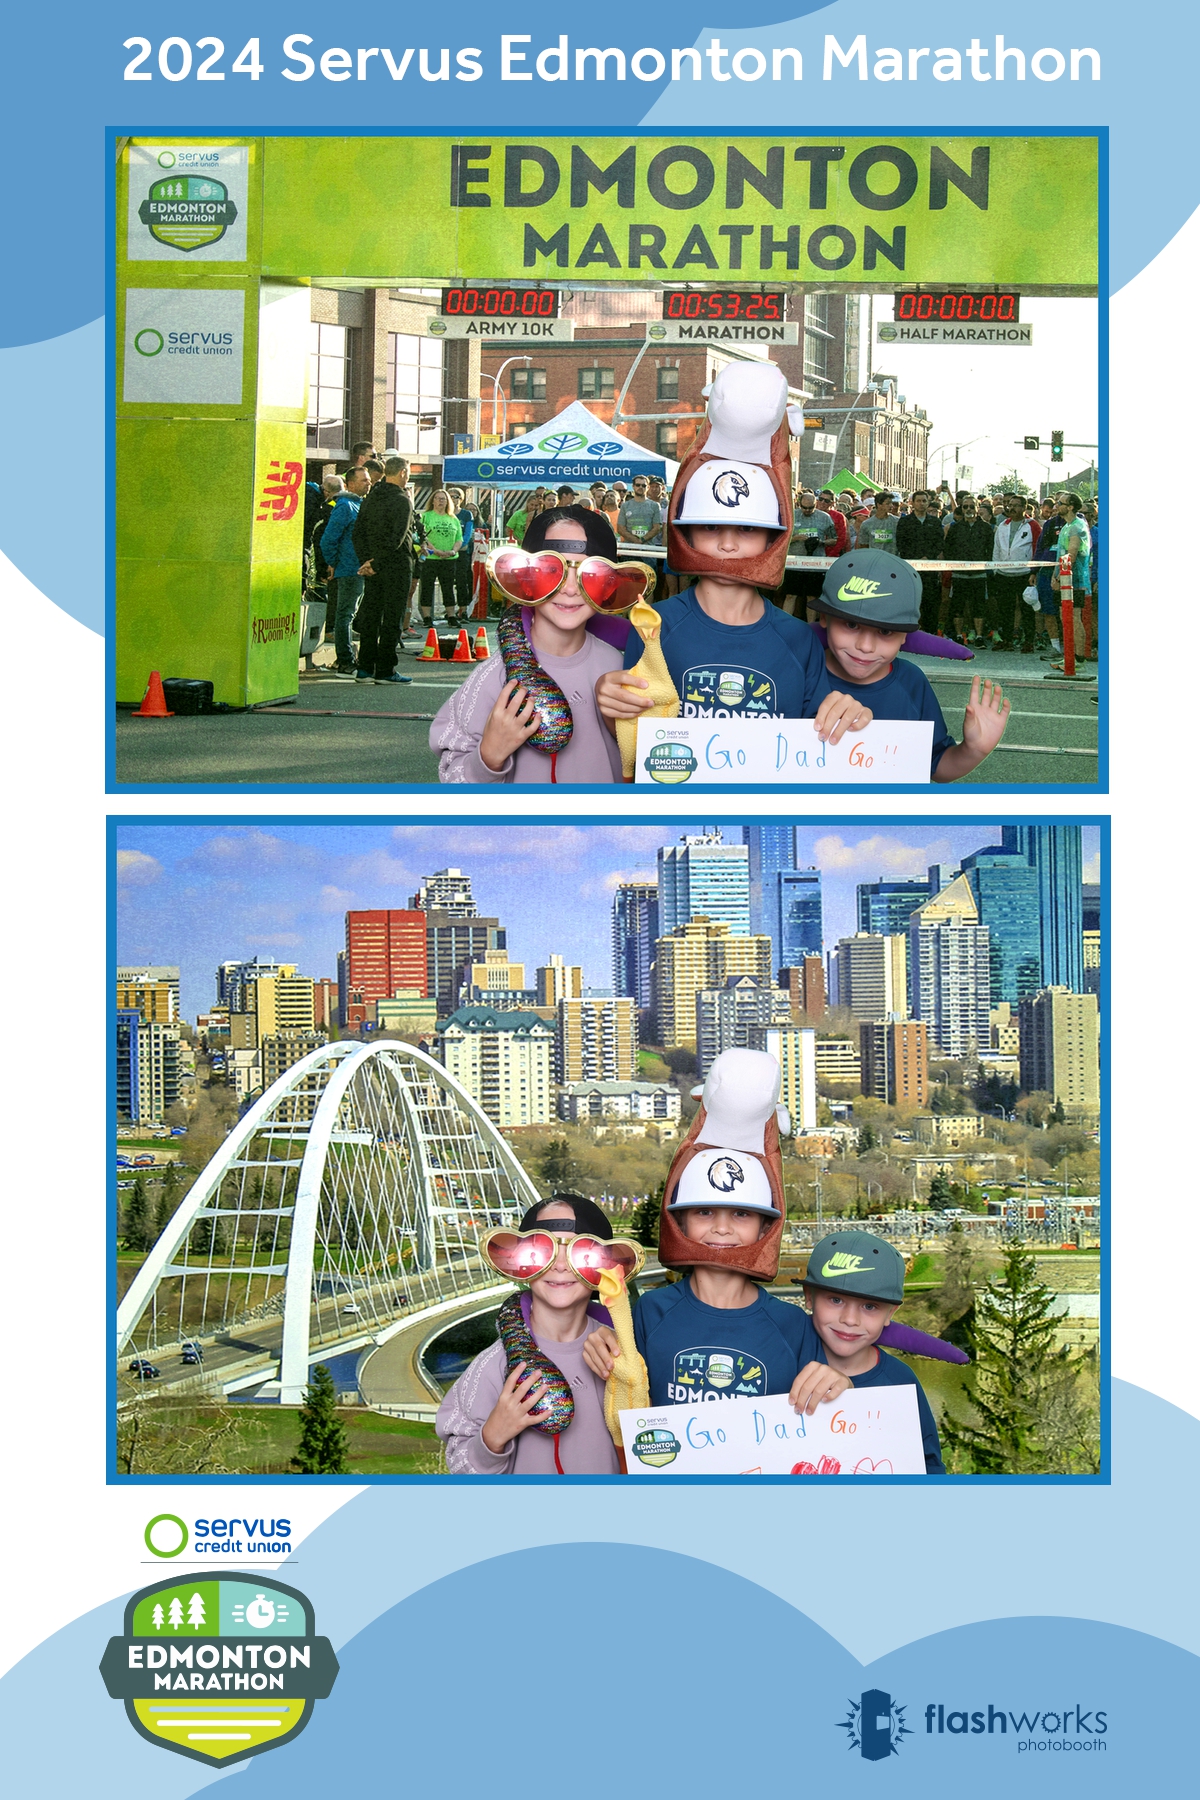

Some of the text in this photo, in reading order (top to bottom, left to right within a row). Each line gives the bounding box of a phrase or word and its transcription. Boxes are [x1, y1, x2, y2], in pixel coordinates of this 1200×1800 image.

[178, 152, 219, 161] servus
[449, 145, 991, 211] EDMONTON
[149, 203, 227, 214] EDMONTON
[160, 214, 215, 222] MARATHON
[523, 223, 907, 271] MARATHON
[465, 321, 554, 336] ARMY 10K
[678, 325, 785, 340] MARATHON
[900, 328, 939, 340] HALF
[943, 328, 1031, 341] MARATHON
[168, 331, 233, 345] servus
[167, 345, 233, 355] credit union
[496, 463, 631, 477] servus credit union
[844, 575, 881, 596] NIKE
[257, 613, 291, 643] Running
[705, 733, 747, 770] Go
[775, 732, 826, 772] Dad
[828, 1251, 864, 1270] NIKE
[685, 1416, 727, 1450] Go
[752, 1409, 807, 1445] Dad
[636, 1441, 676, 1451] EDMONTON
